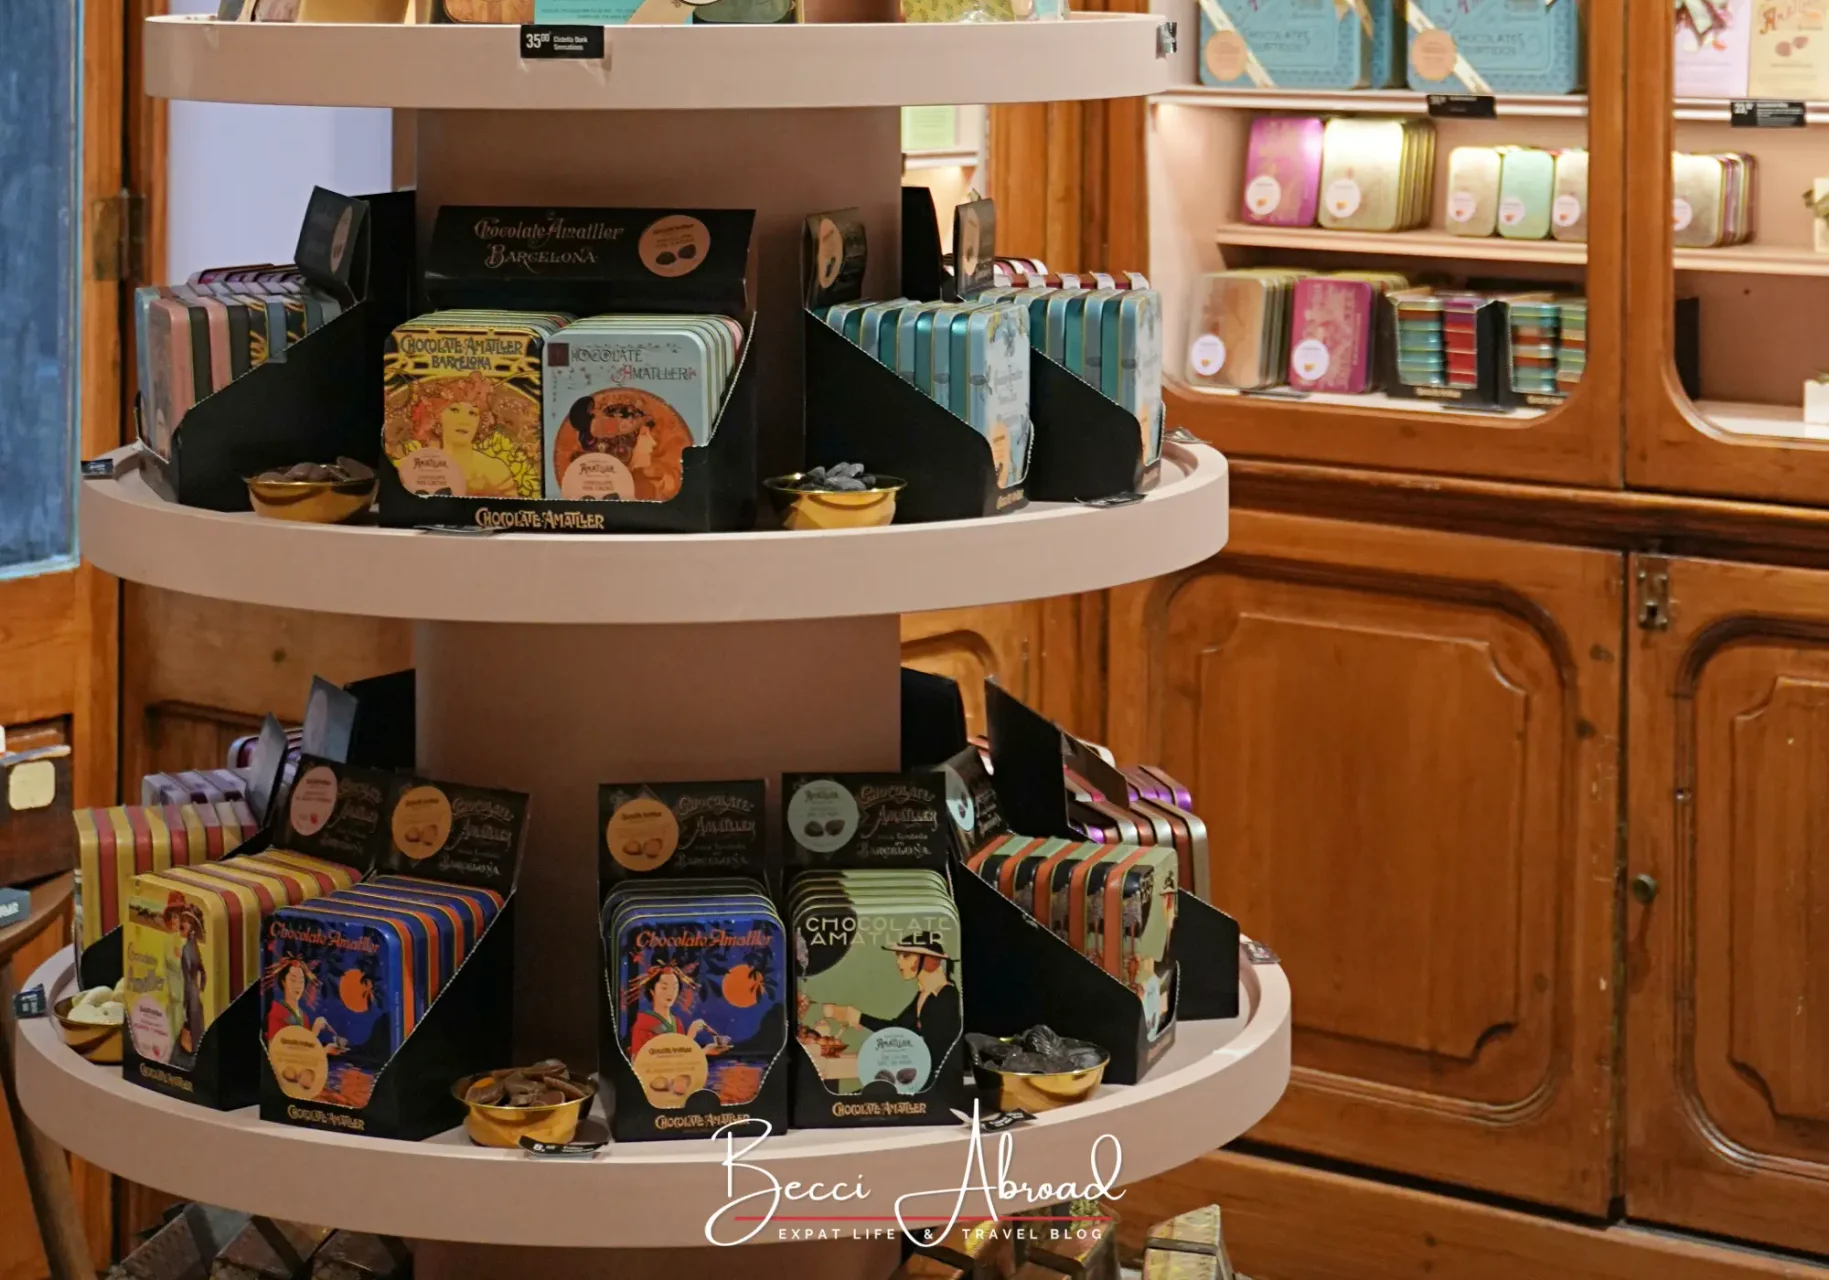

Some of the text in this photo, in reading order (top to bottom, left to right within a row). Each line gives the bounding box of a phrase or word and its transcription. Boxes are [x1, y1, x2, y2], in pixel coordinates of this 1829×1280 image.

[400, 334, 524, 355] CHOCOLATE AMATLLER
[475, 507, 605, 530] CHOCOLATE AMATLLER
[806, 917, 952, 933] CHOCOLATE
[635, 929, 773, 948] Chocolate Amatller
[811, 931, 945, 947] AMATLLER
[832, 1101, 927, 1117] CHOCOLATE AMATLLER
